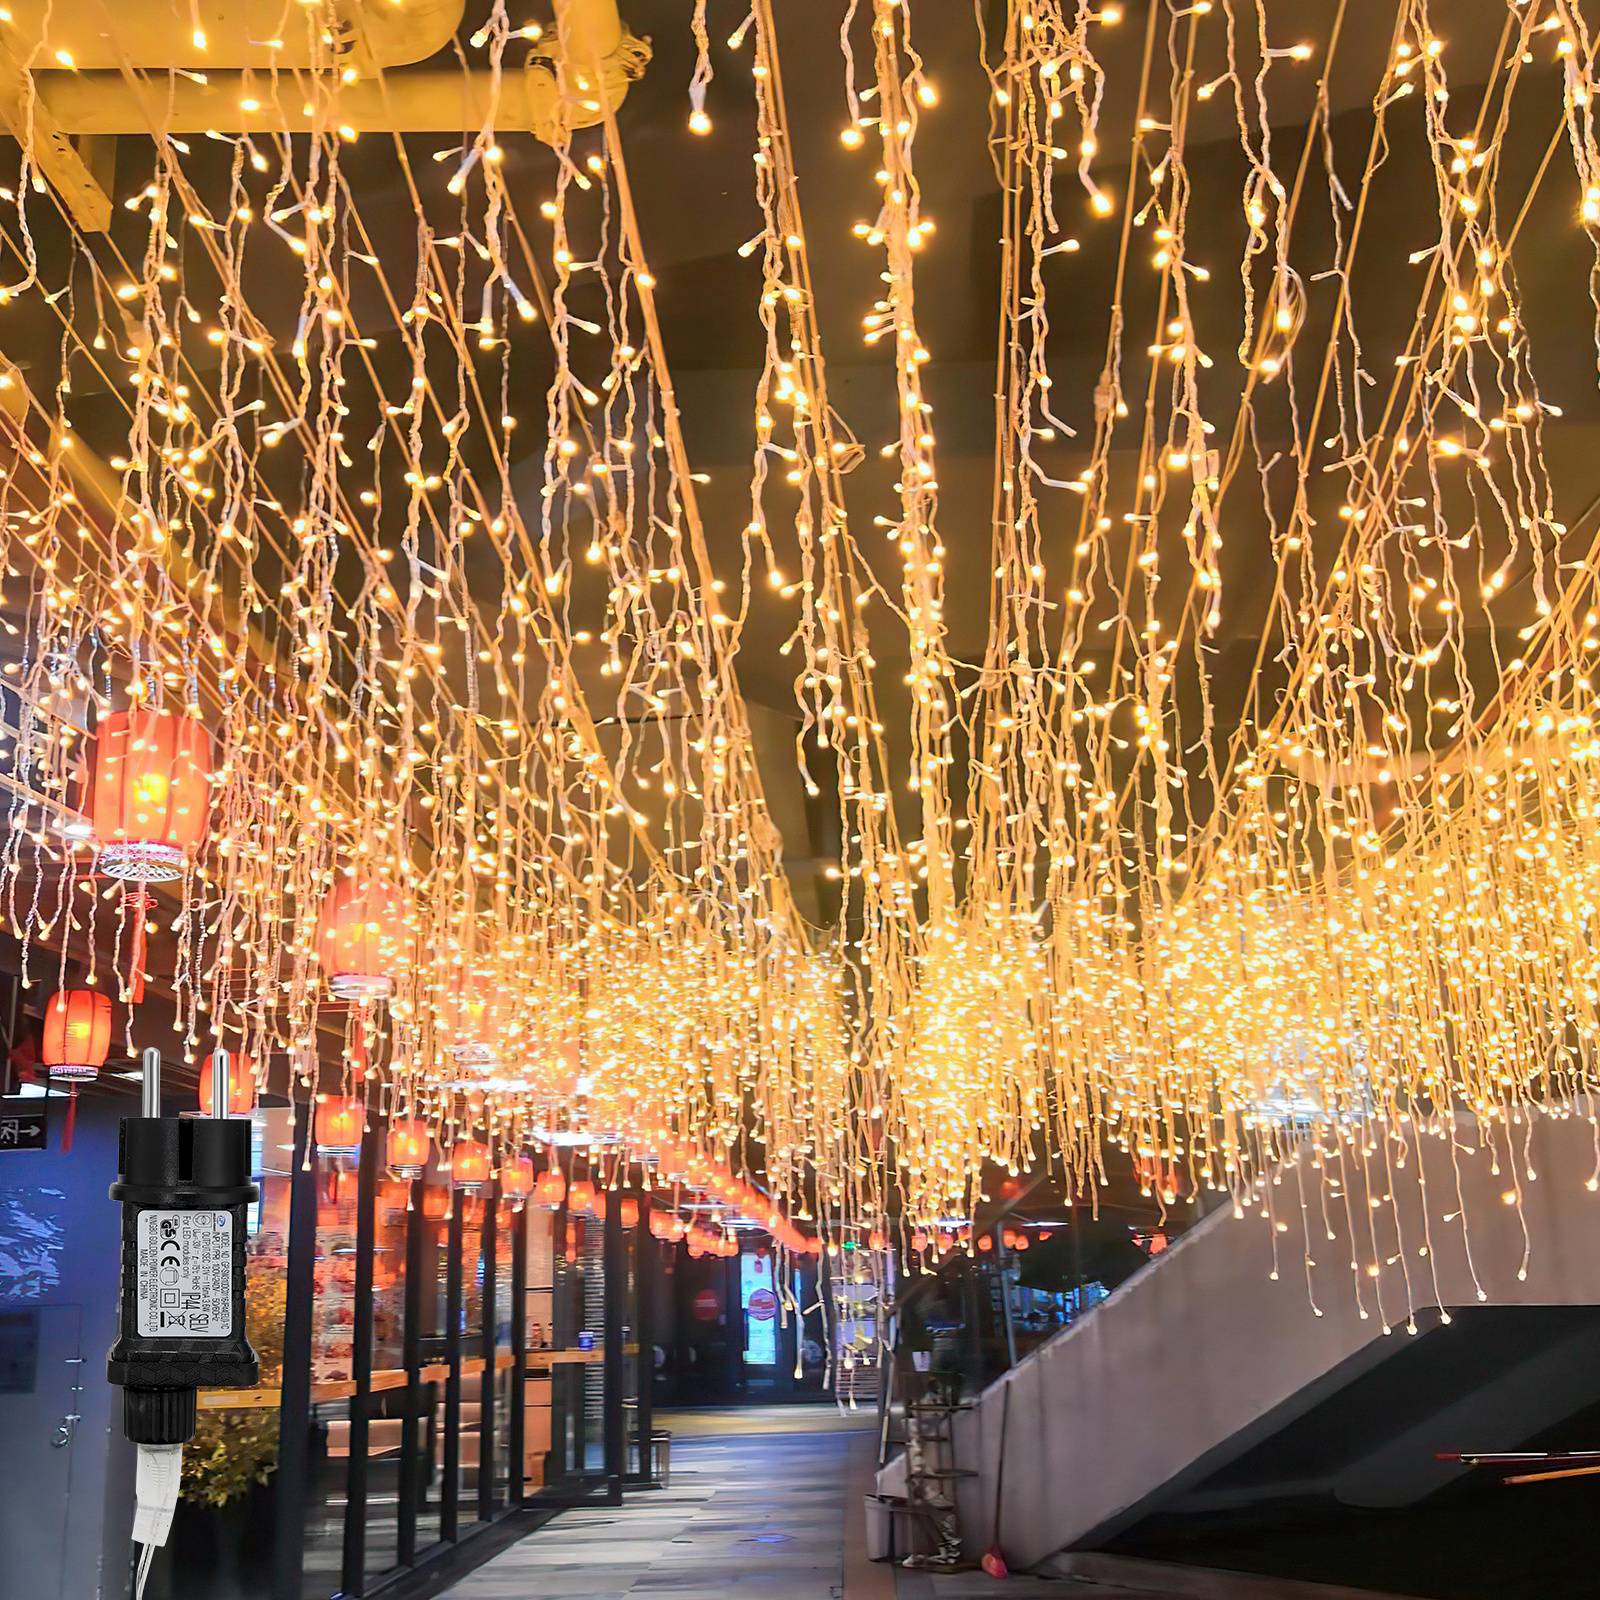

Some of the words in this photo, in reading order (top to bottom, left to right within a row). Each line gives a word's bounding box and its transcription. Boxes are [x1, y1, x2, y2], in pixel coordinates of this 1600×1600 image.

[149, 1215, 158, 1235] NINGBO
[183, 1216, 191, 1226] For
[183, 1227, 191, 1239] LED
[149, 1236, 158, 1257] GOLDEN
[140, 1249, 148, 1267] MADE
[149, 1259, 158, 1277] POWER
[181, 1267, 190, 1279] only
[140, 1280, 148, 1300] CHINA
[149, 1279, 158, 1310] ELECTRONIC
[181, 1292, 201, 1310] IP44
[189, 1314, 209, 1332] SELV
